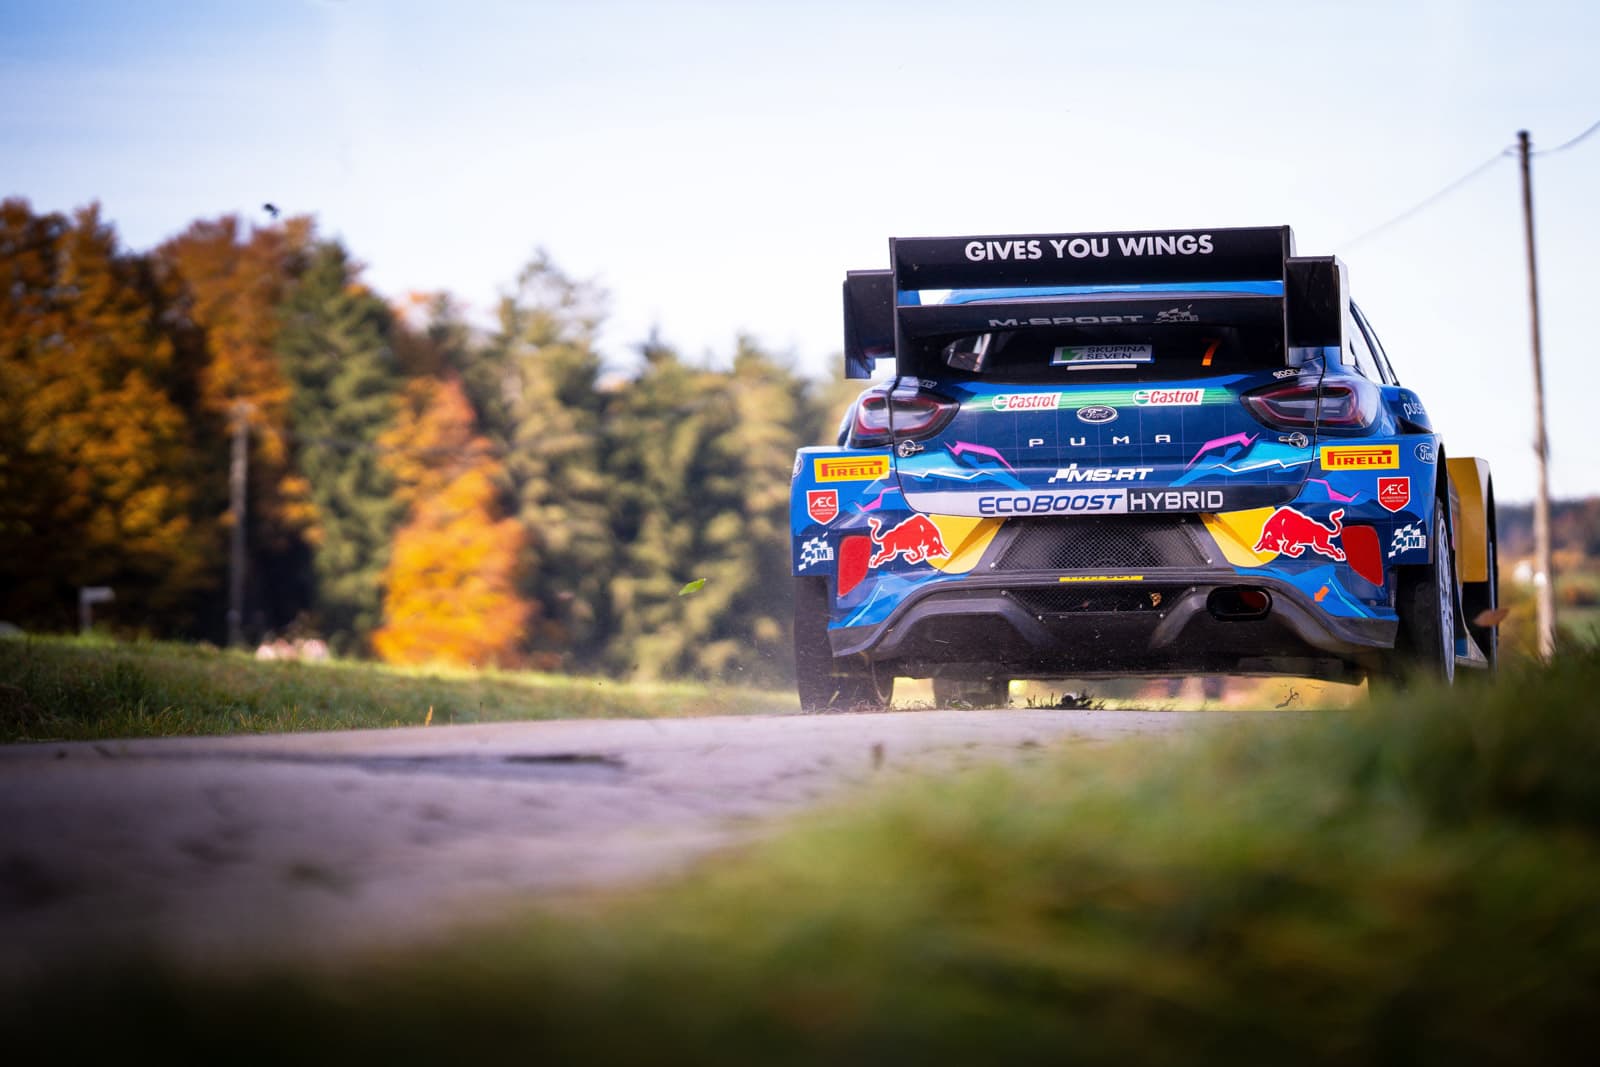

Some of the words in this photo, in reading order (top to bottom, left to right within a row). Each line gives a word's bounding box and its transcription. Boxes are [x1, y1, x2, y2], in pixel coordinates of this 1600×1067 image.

[965, 240, 1042, 261] GIVES
[1050, 238, 1109, 258] YOU
[1118, 235, 1214, 256] WINGS
[988, 315, 1144, 327] M-SPORT
[1008, 394, 1057, 408] Castrol
[1150, 390, 1200, 403] Castrol
[1085, 408, 1109, 418] Ford
[1029, 434, 1171, 448] PUMA
[1327, 450, 1392, 465] PIRELLI
[821, 460, 883, 477] PIRELLI
[1067, 468, 1154, 482] MS-RT
[978, 495, 1123, 514] ECOBOOST
[1129, 491, 1223, 511] HYBRID
